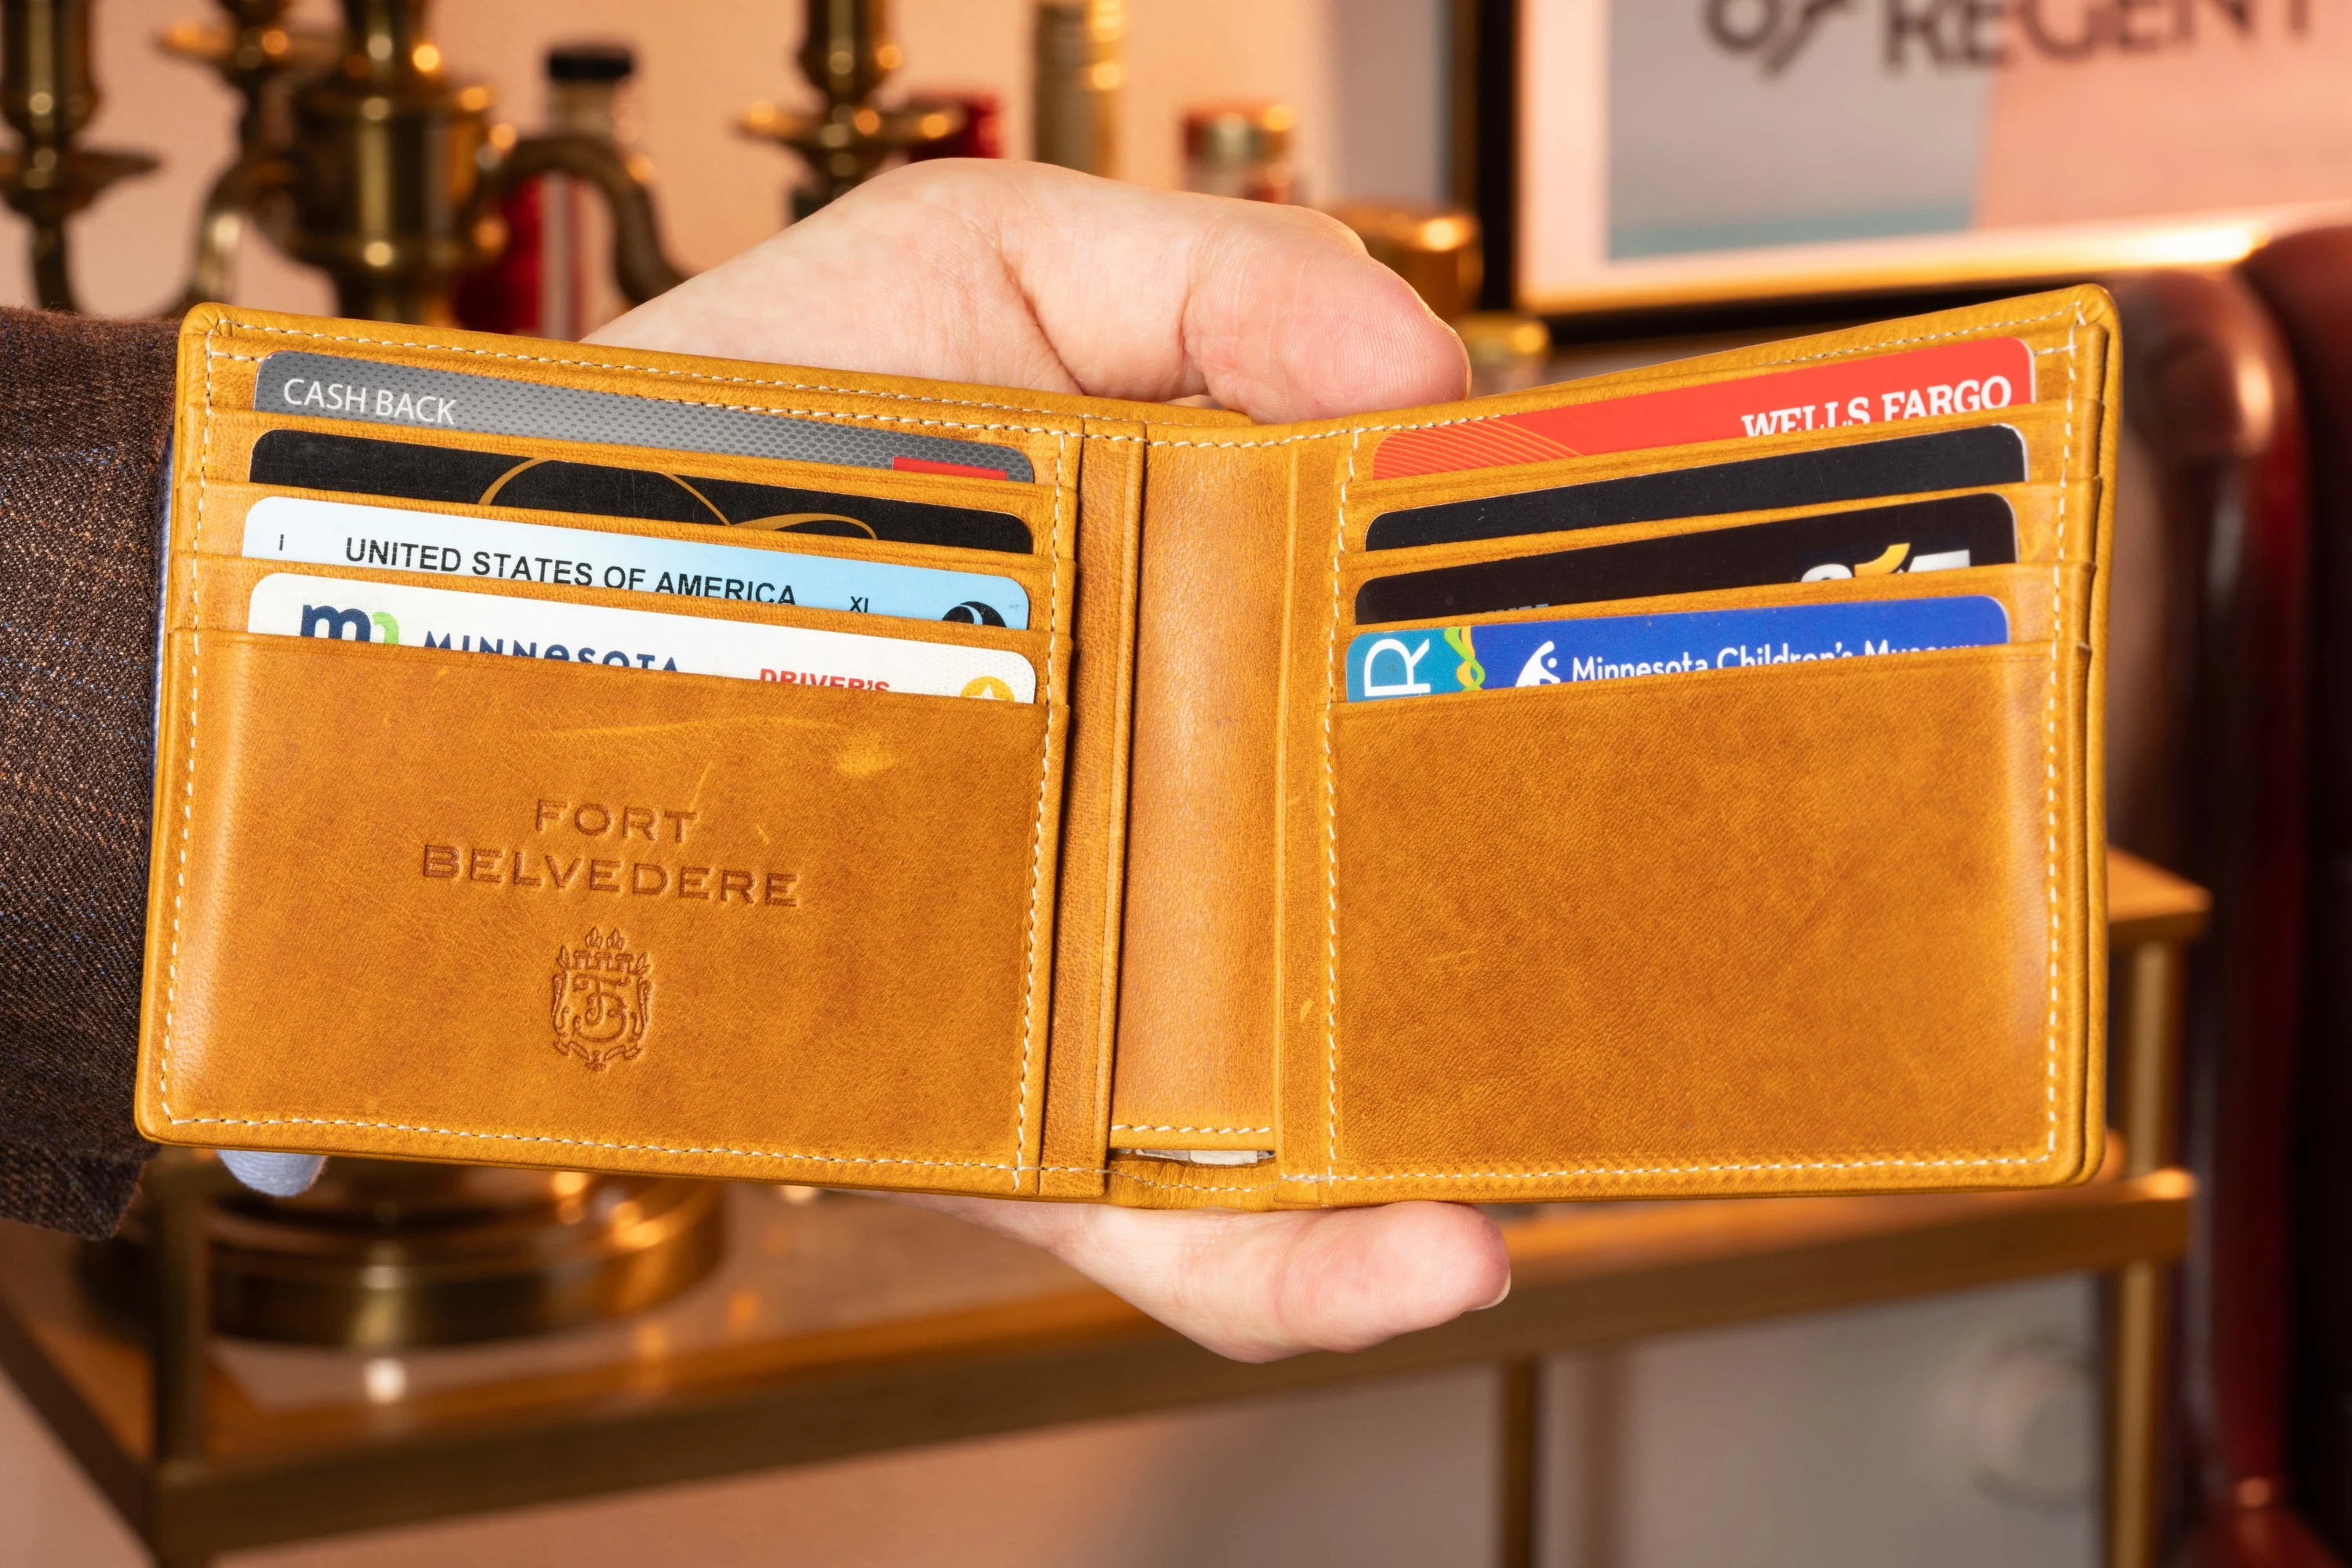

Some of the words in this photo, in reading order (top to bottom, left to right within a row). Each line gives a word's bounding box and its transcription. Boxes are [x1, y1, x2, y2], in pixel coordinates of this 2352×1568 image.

[284, 378, 367, 413] CASH
[376, 390, 458, 425] BACK
[1740, 397, 1871, 437] WELLS
[1882, 376, 2012, 422] FARGO
[346, 537, 461, 572] UNITED
[472, 551, 593, 586] STATES
[604, 565, 646, 590] OF
[655, 572, 797, 605] AMERICA
[850, 596, 869, 614] XI
[1364, 638, 1431, 697] R
[1573, 652, 1708, 681] Minnesota
[535, 798, 698, 844] FORT
[423, 843, 798, 908] BELVEDERE
